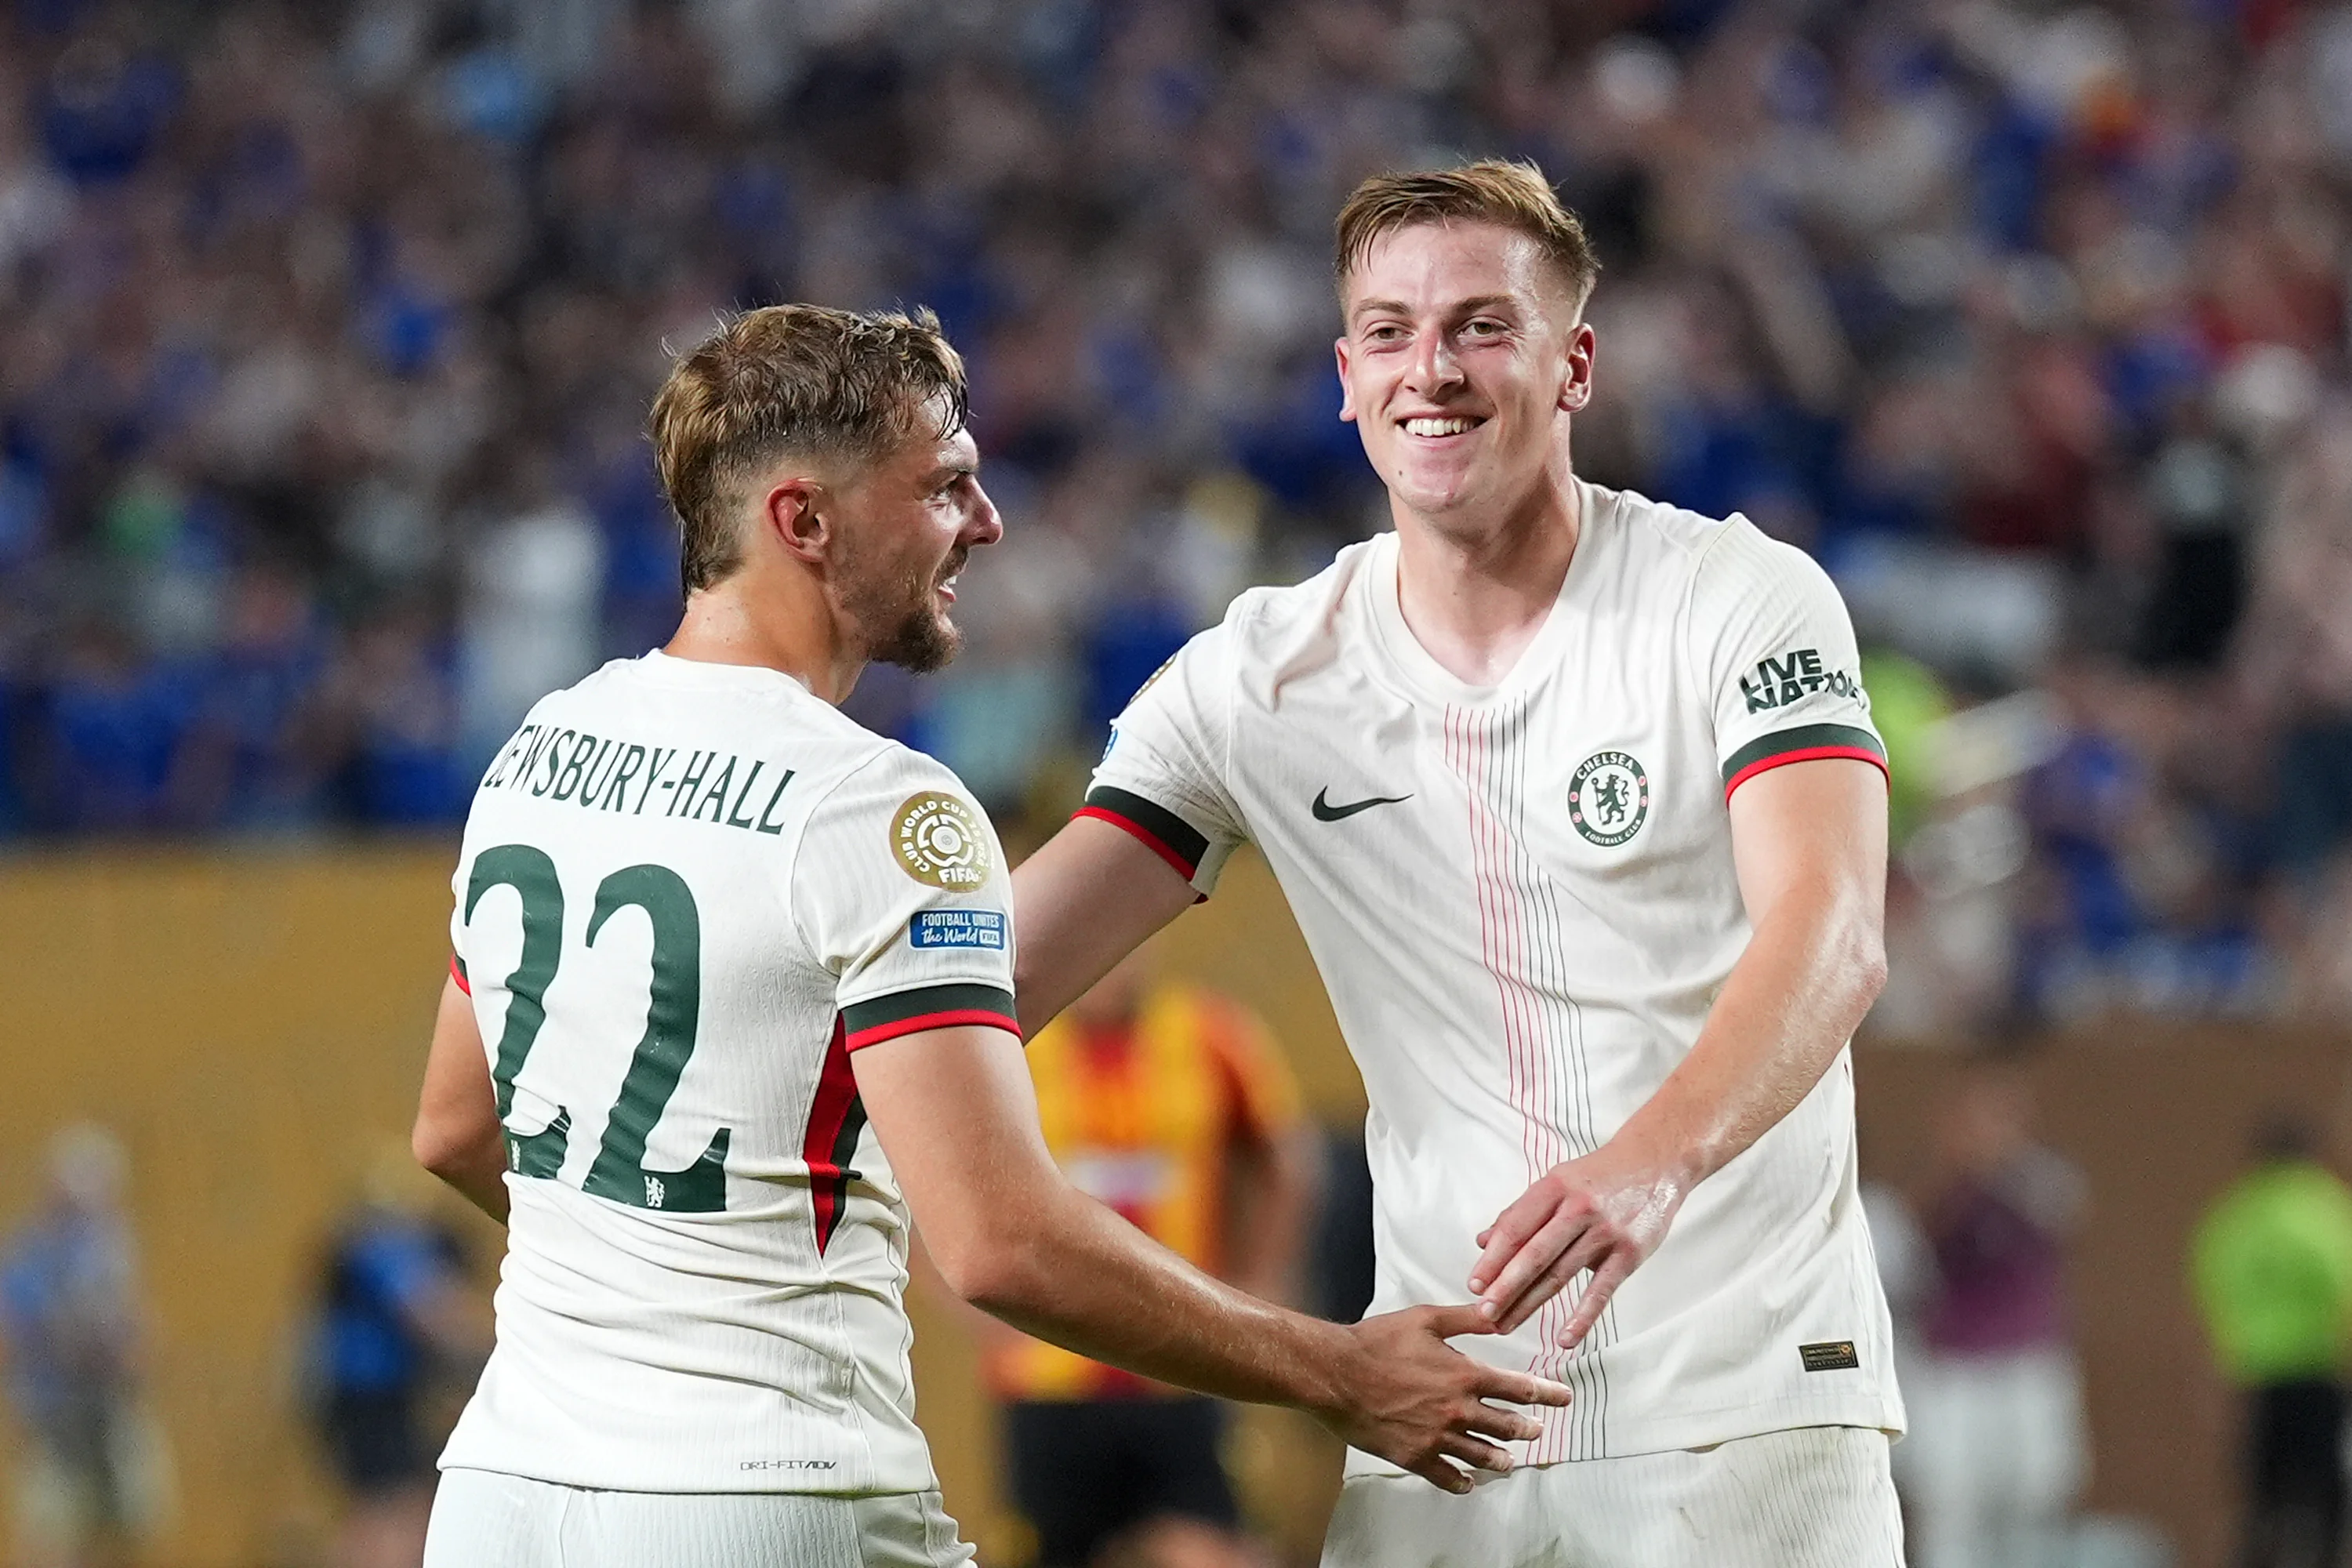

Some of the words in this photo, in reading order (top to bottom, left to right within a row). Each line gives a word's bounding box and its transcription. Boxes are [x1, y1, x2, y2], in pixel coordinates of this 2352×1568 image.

[1739, 649, 1822, 694] LIVE
[1576, 753, 1634, 779] CHELSEA
[485, 725, 797, 835] EWSBURY-HALL
[901, 800, 938, 838] WORLD
[941, 800, 968, 818] CUP
[1585, 831, 1624, 844] FOOTBALL
[902, 841, 930, 873] CLUB
[938, 867, 979, 884] FIFA
[922, 913, 972, 927] FOOTBALL
[921, 927, 943, 944] the
[943, 927, 978, 945] World
[465, 844, 731, 1212] 22
